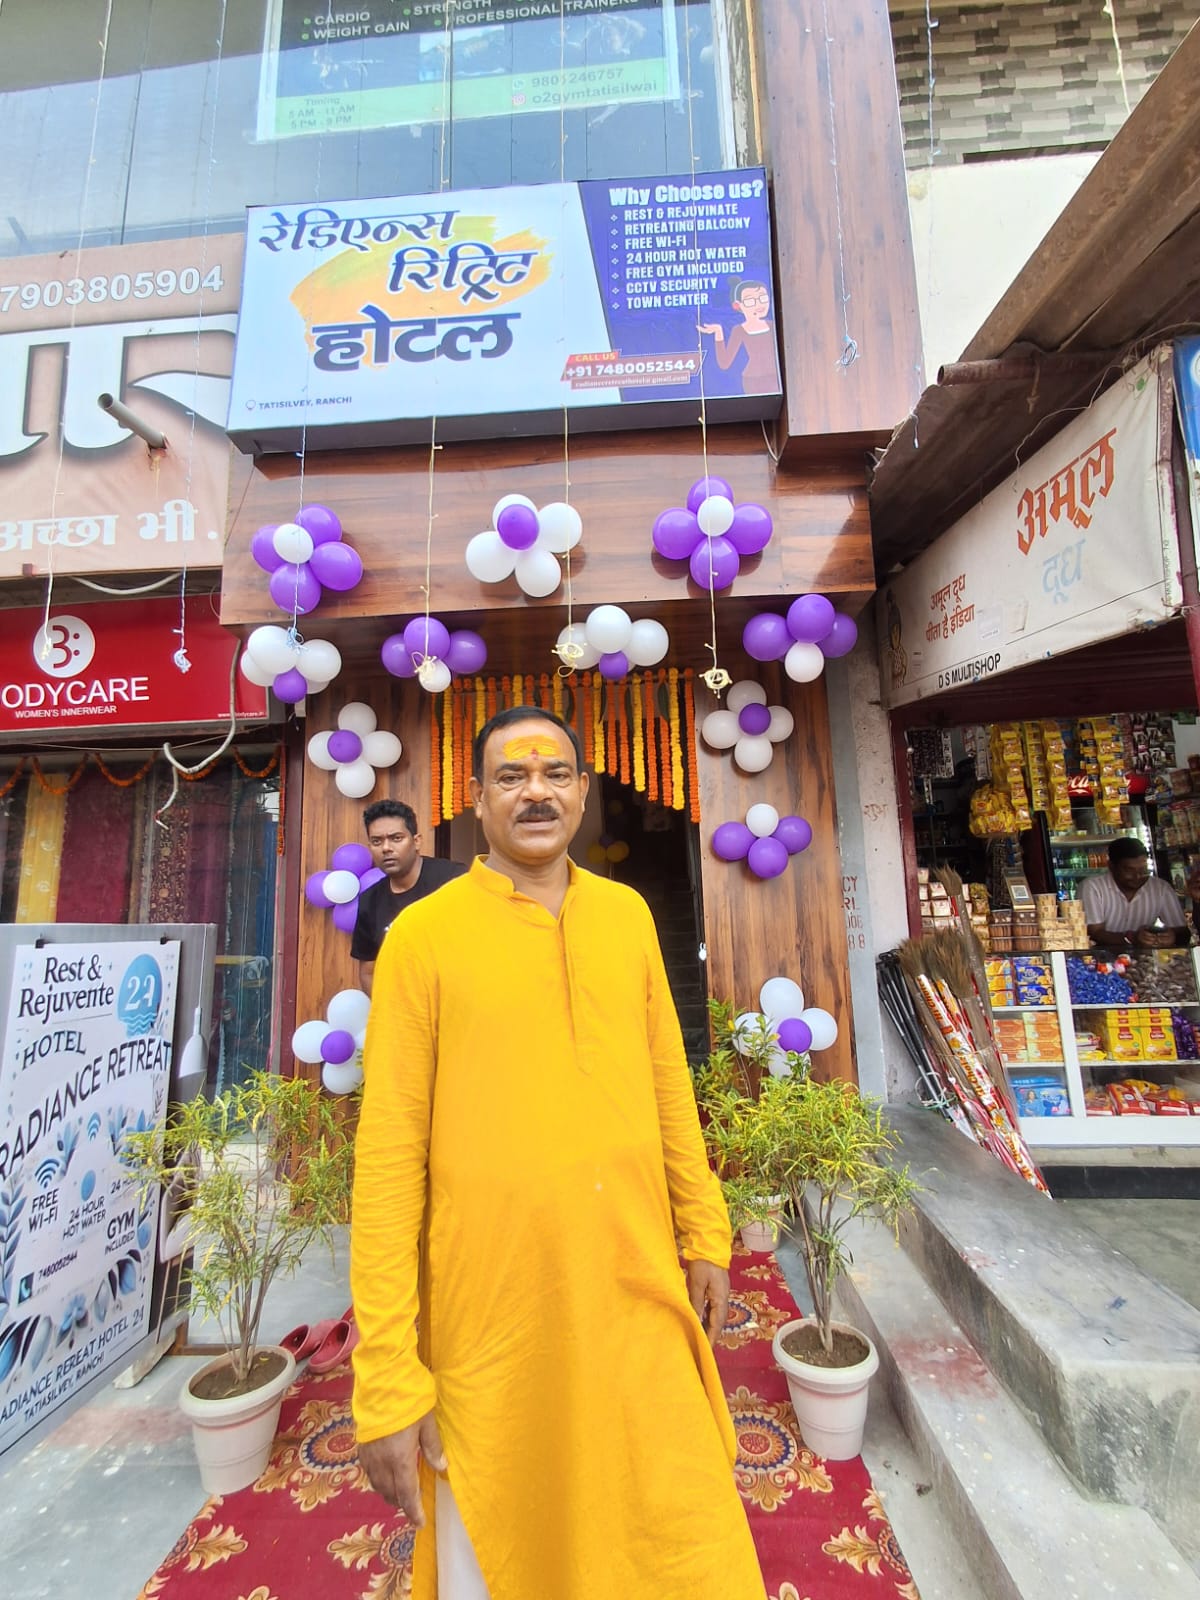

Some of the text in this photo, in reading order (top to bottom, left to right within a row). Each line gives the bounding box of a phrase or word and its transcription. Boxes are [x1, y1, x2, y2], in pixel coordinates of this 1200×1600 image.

[314, 11, 370, 25] CARDIO
[413, 0, 492, 16] STRENGTH
[564, 0, 639, 12] TRAINE
[313, 21, 410, 39] WEIGHT GAIN
[609, 179, 764, 206] Why Choose us?
[624, 203, 739, 221] REST & REJUVINATE
[259, 208, 460, 251] रेडिएन्स
[624, 216, 751, 236] RETREATING BALCONY
[625, 235, 687, 250] FREE WI-FI
[626, 246, 747, 264] 24 HOUR HOT WATER
[625, 261, 744, 280] FREE GYM INCLUDED
[0, 265, 224, 312] 7903805904
[626, 277, 718, 294] CCTV SECURITY
[626, 293, 709, 309] TOWN CENTER
[311, 304, 522, 372] होटल
[566, 359, 696, 377] +91 7480052544
[575, 353, 616, 362] CALL US
[259, 396, 353, 411] TATISILVEY, RANCHI
[1017, 427, 1118, 556] अमूल
[1041, 537, 1087, 606] दूध
[930, 574, 966, 612] अमूल दूध
[925, 604, 976, 642] पीता है इंडिया
[945, 672, 951, 686] S
[951, 652, 1001, 684] MULTISHOP
[1, 676, 150, 708] ODYCARE
[15, 705, 117, 719] WOMEN'S INNERWEAR
[43, 954, 102, 984] Rest &
[18, 984, 115, 1025] Rejuvente
[22, 1030, 87, 1071] HOTEL
[0, 1038, 172, 1182] RADIANCE RETREAT
[32, 1188, 59, 1213] FREE
[69, 1195, 105, 1223] 24 HOUR
[28, 1206, 59, 1233] WI-FI
[63, 1209, 107, 1240] HOT WATER
[107, 1207, 136, 1239] GYM
[104, 1231, 136, 1255] INCLUDED
[98, 1315, 129, 1350] HOTEL
[76, 1351, 105, 1381] RANCHI
